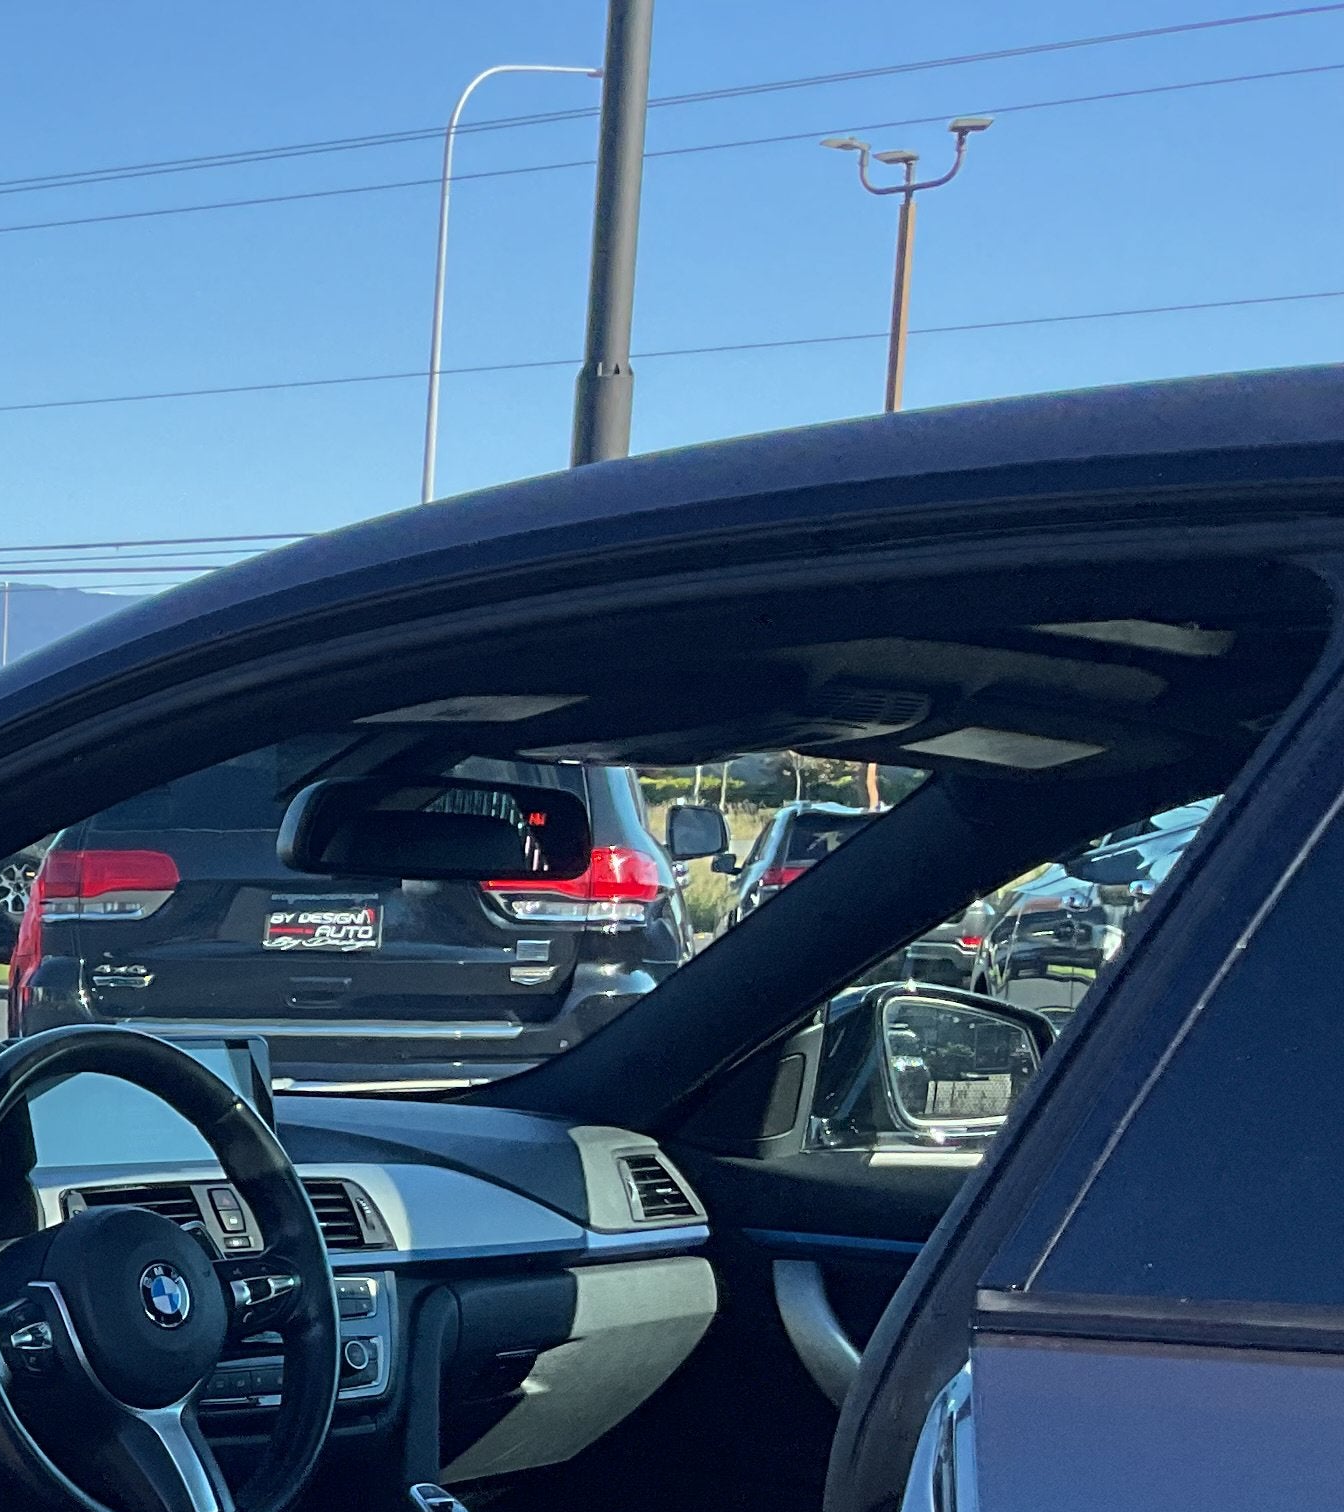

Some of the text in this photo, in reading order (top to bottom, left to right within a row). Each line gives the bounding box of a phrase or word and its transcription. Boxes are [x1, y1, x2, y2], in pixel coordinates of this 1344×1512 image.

[270, 912, 366, 924] BY DESIGN
[314, 925, 373, 938] AUTO
